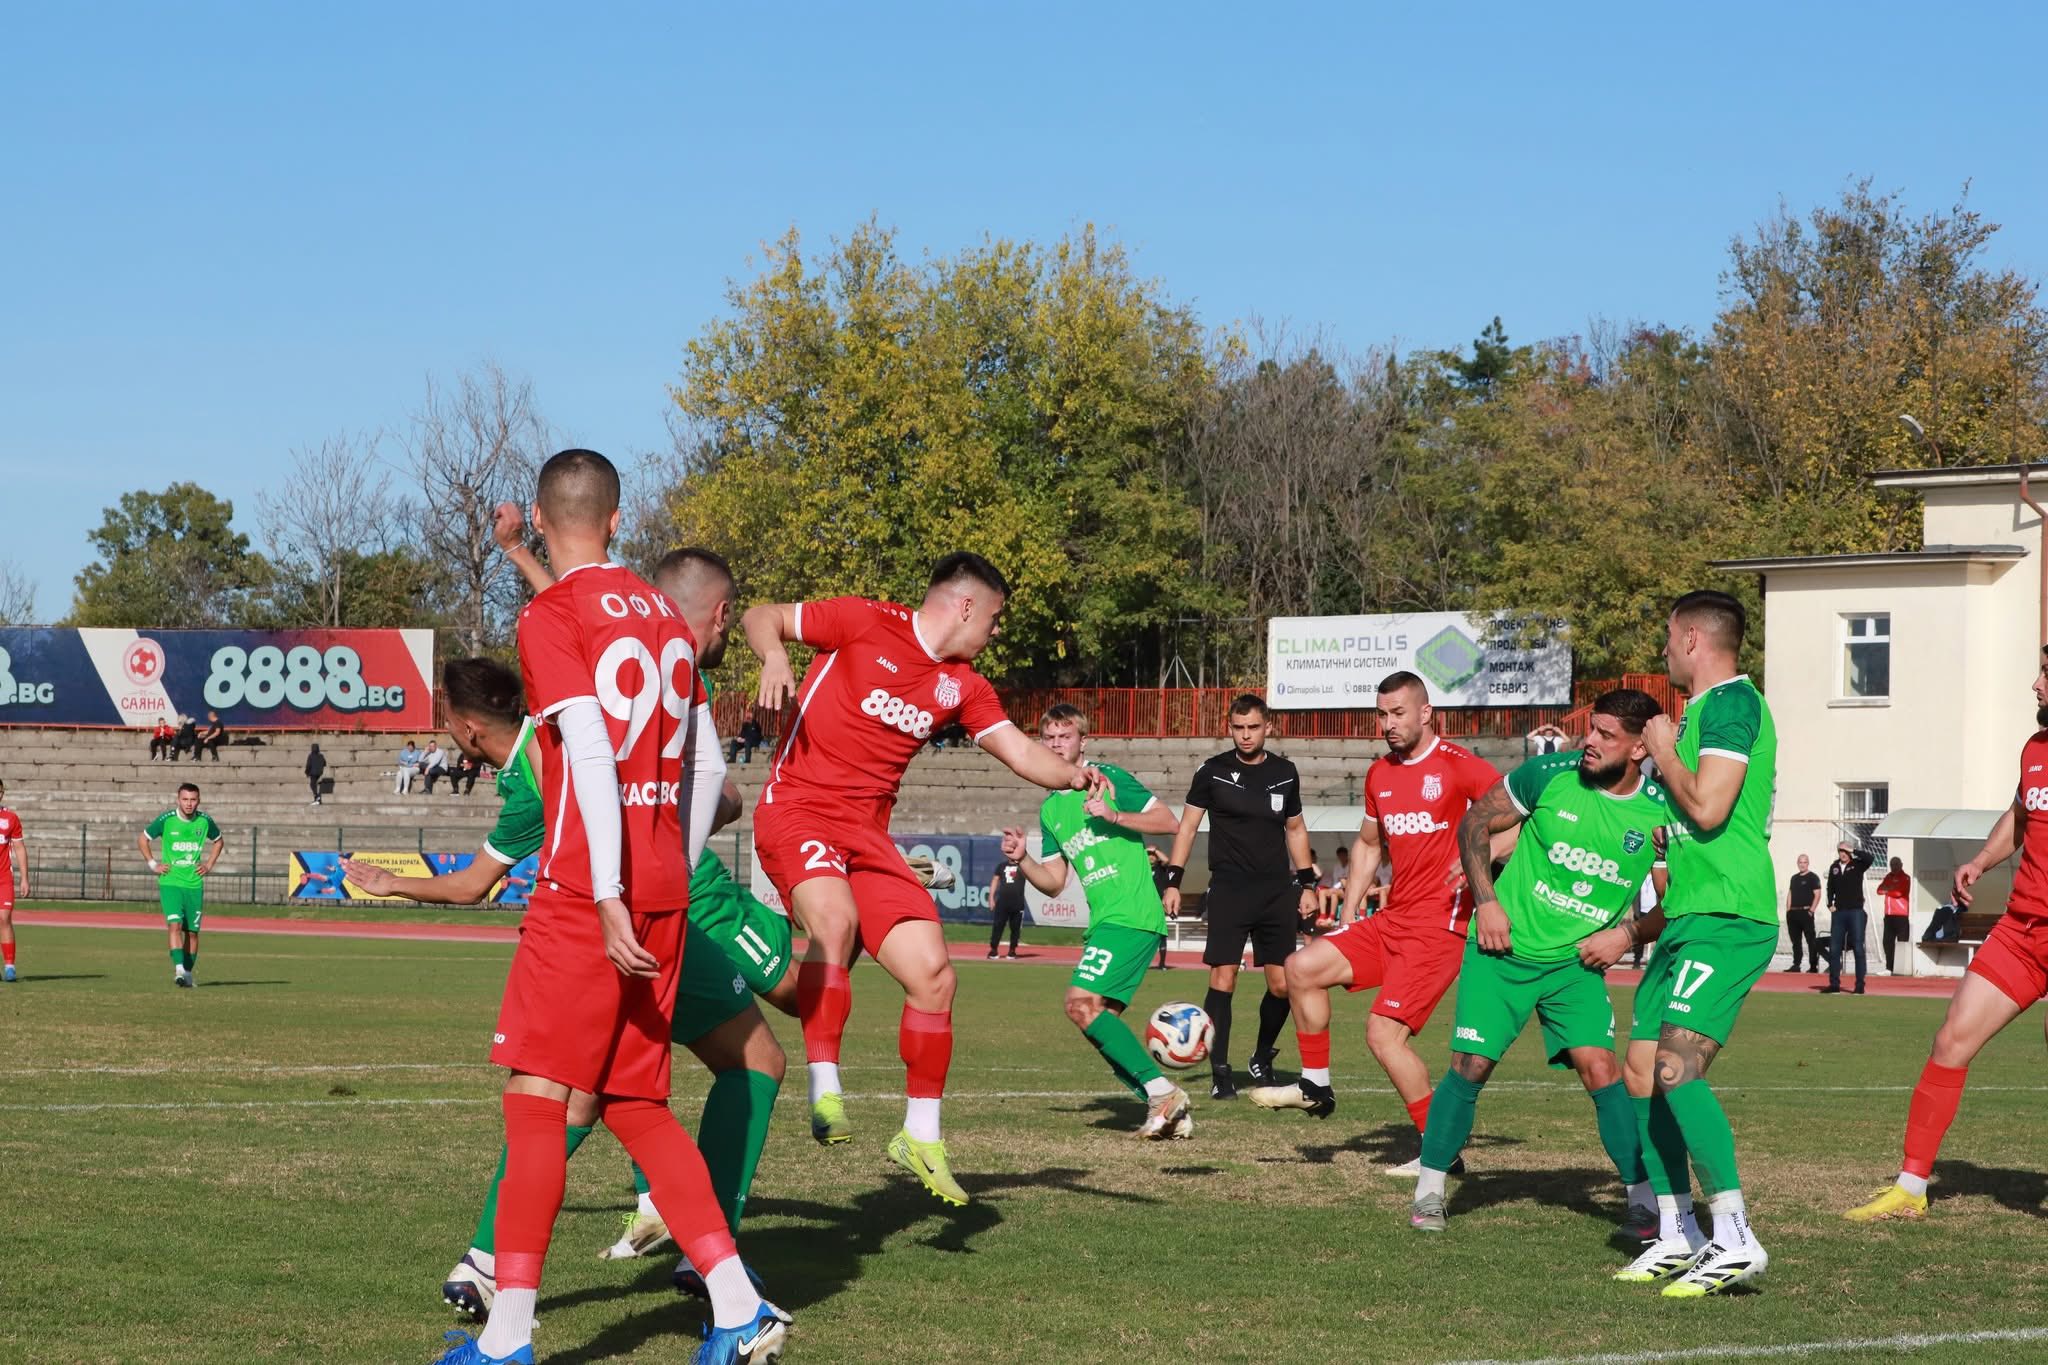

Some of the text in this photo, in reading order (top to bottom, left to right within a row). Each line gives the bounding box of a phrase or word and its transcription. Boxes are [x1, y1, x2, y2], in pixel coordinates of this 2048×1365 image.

[601, 593, 675, 618] ОФК
[1277, 634, 1408, 654] CLIMAPOLIS
[876, 656, 898, 673] JAKO
[1286, 656, 1398, 670] КЛИМАТИЧНИ СИСТЕМИ
[1489, 661, 1535, 673] МОНТАЖ
[203, 645, 403, 709] 8888.BG
[595, 637, 694, 761] 99
[1489, 683, 1529, 694] СЕРВИЗ
[121, 697, 166, 711] САЯНА
[1557, 809, 1578, 823] JAKO
[1548, 841, 1633, 889] 8888.BG
[1042, 903, 1077, 918] САЯНА
[1534, 879, 1610, 924] INSAOIL
[734, 924, 771, 966] 11
[763, 955, 781, 977] JAKO
[1078, 946, 1113, 976] 23
[1673, 960, 1714, 999] 17
[1668, 1001, 1691, 1013] JAKO
